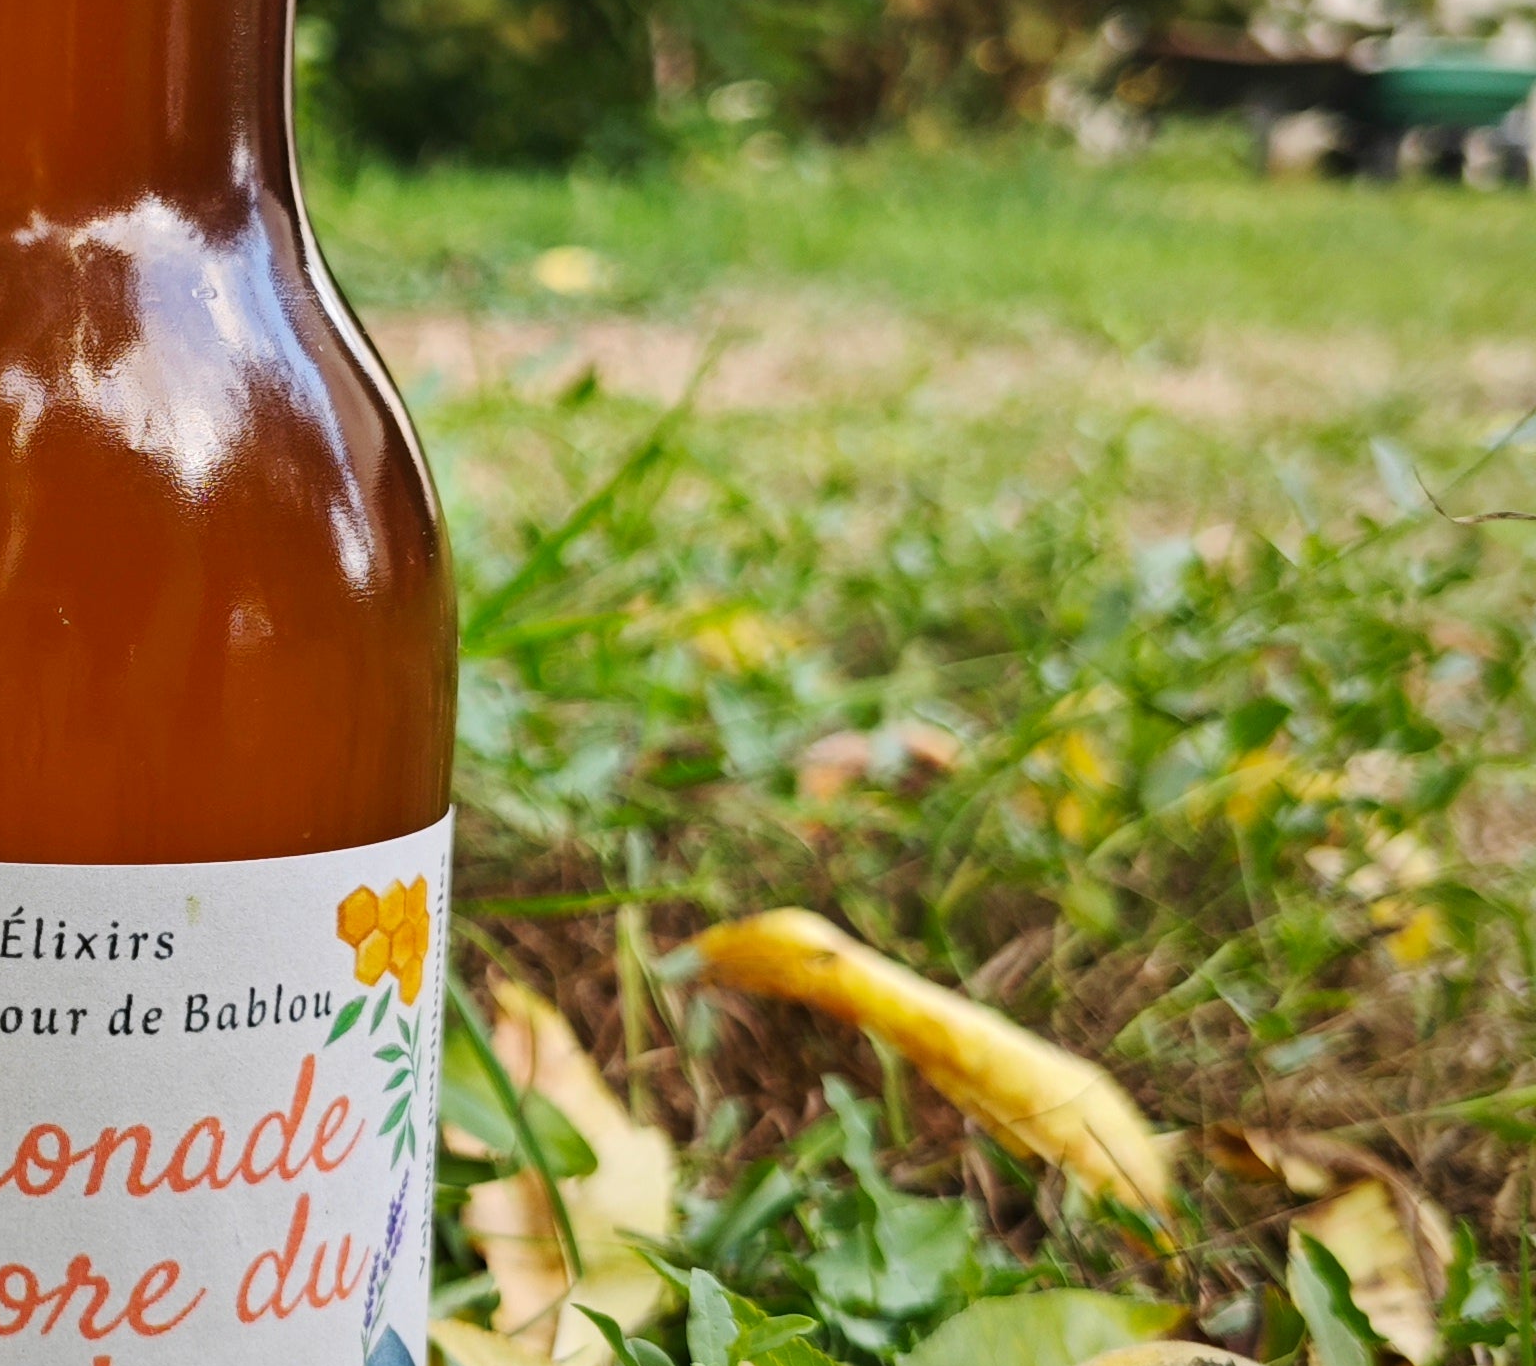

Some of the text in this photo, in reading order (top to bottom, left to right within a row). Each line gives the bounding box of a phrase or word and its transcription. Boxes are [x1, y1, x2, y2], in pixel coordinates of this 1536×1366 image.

[108, 994, 164, 1036] de
[184, 984, 333, 1033] Bablou
[237, 1192, 369, 1325] du
